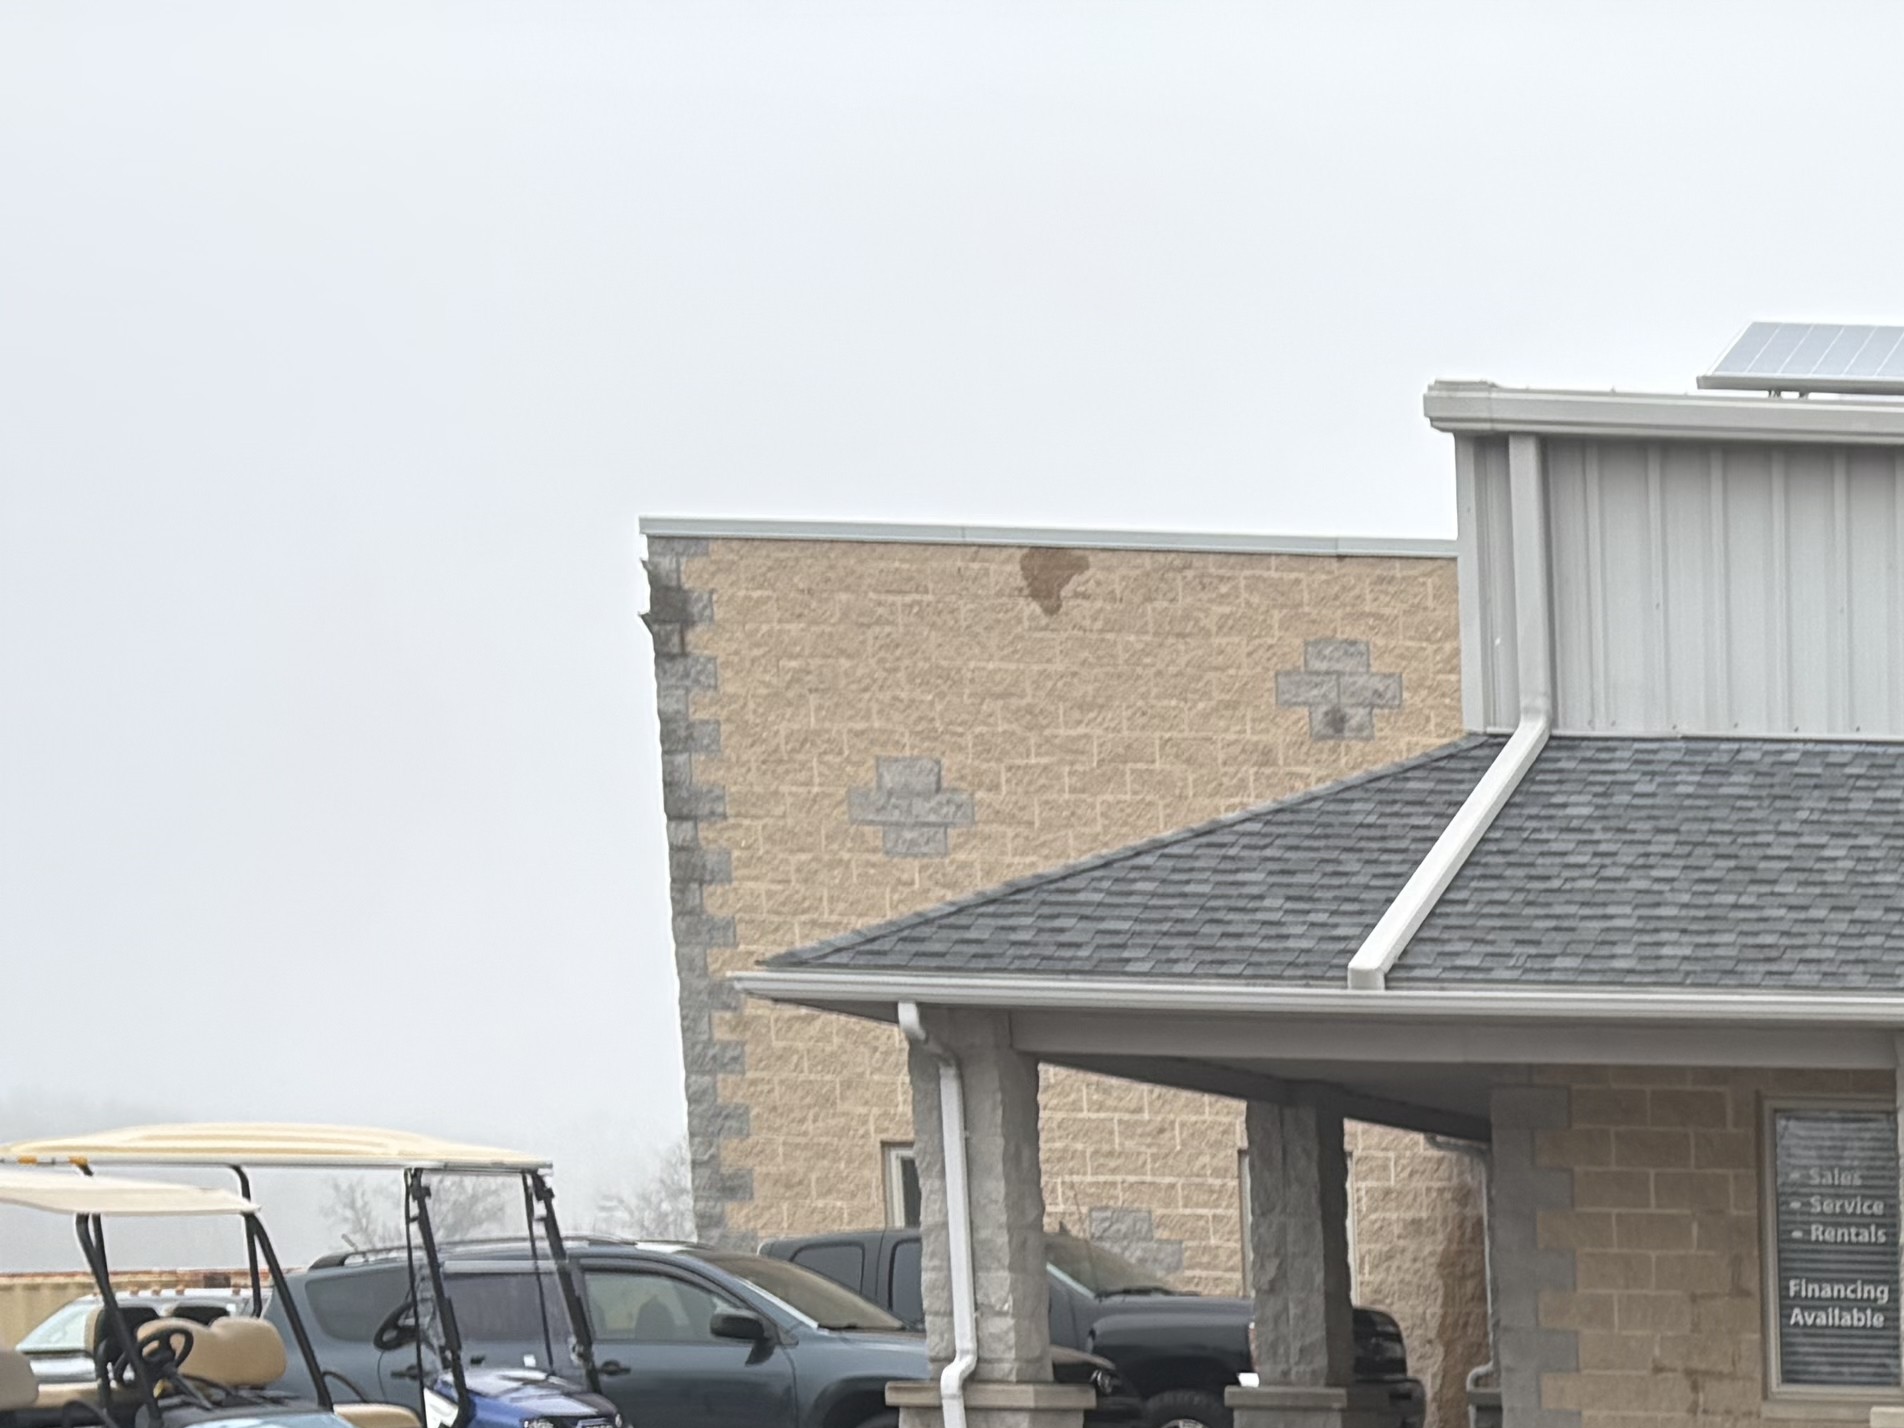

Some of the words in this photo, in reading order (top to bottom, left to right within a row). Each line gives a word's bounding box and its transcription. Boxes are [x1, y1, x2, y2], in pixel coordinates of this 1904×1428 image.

[1808, 1167, 1863, 1186] Sales
[1809, 1195, 1885, 1215] Service
[1810, 1224, 1887, 1244] Rentals
[1789, 1278, 1890, 1304] Financing
[1790, 1307, 1886, 1328] Available
